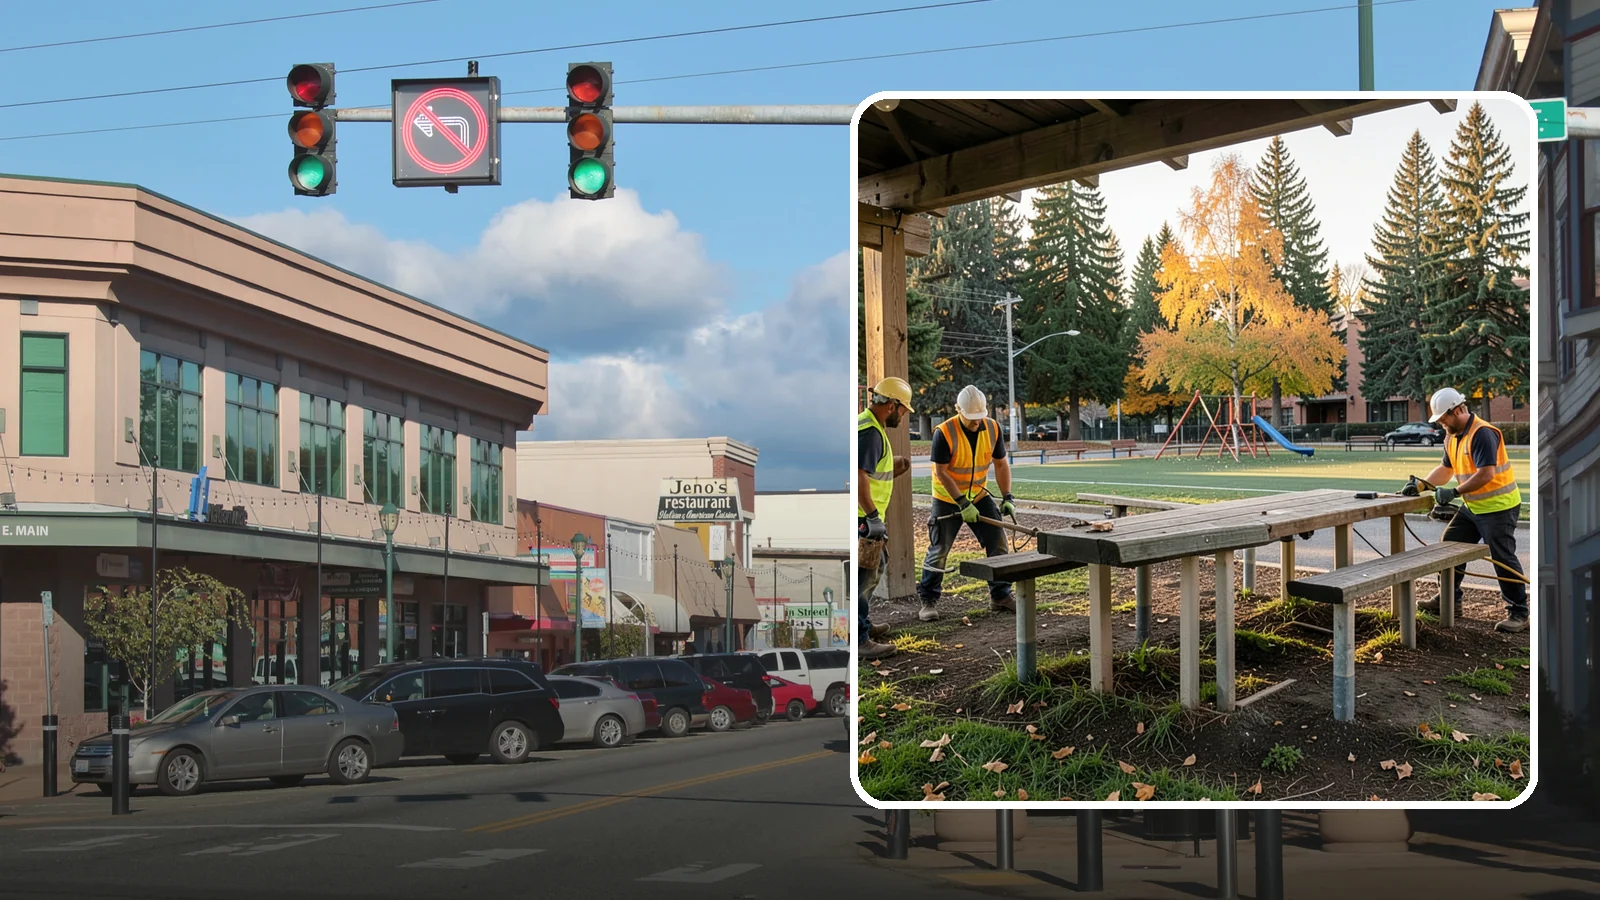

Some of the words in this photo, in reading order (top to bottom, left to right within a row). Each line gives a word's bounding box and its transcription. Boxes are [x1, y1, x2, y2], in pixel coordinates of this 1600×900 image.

[669, 480, 727, 494] Jeno's
[665, 497, 731, 509] restaurant
[659, 510, 681, 519] Italian
[686, 510, 714, 519] American
[715, 510, 737, 519] Cuisine
[2, 525, 13, 536] E.
[15, 525, 49, 536] MAIN
[797, 608, 828, 616] Street
